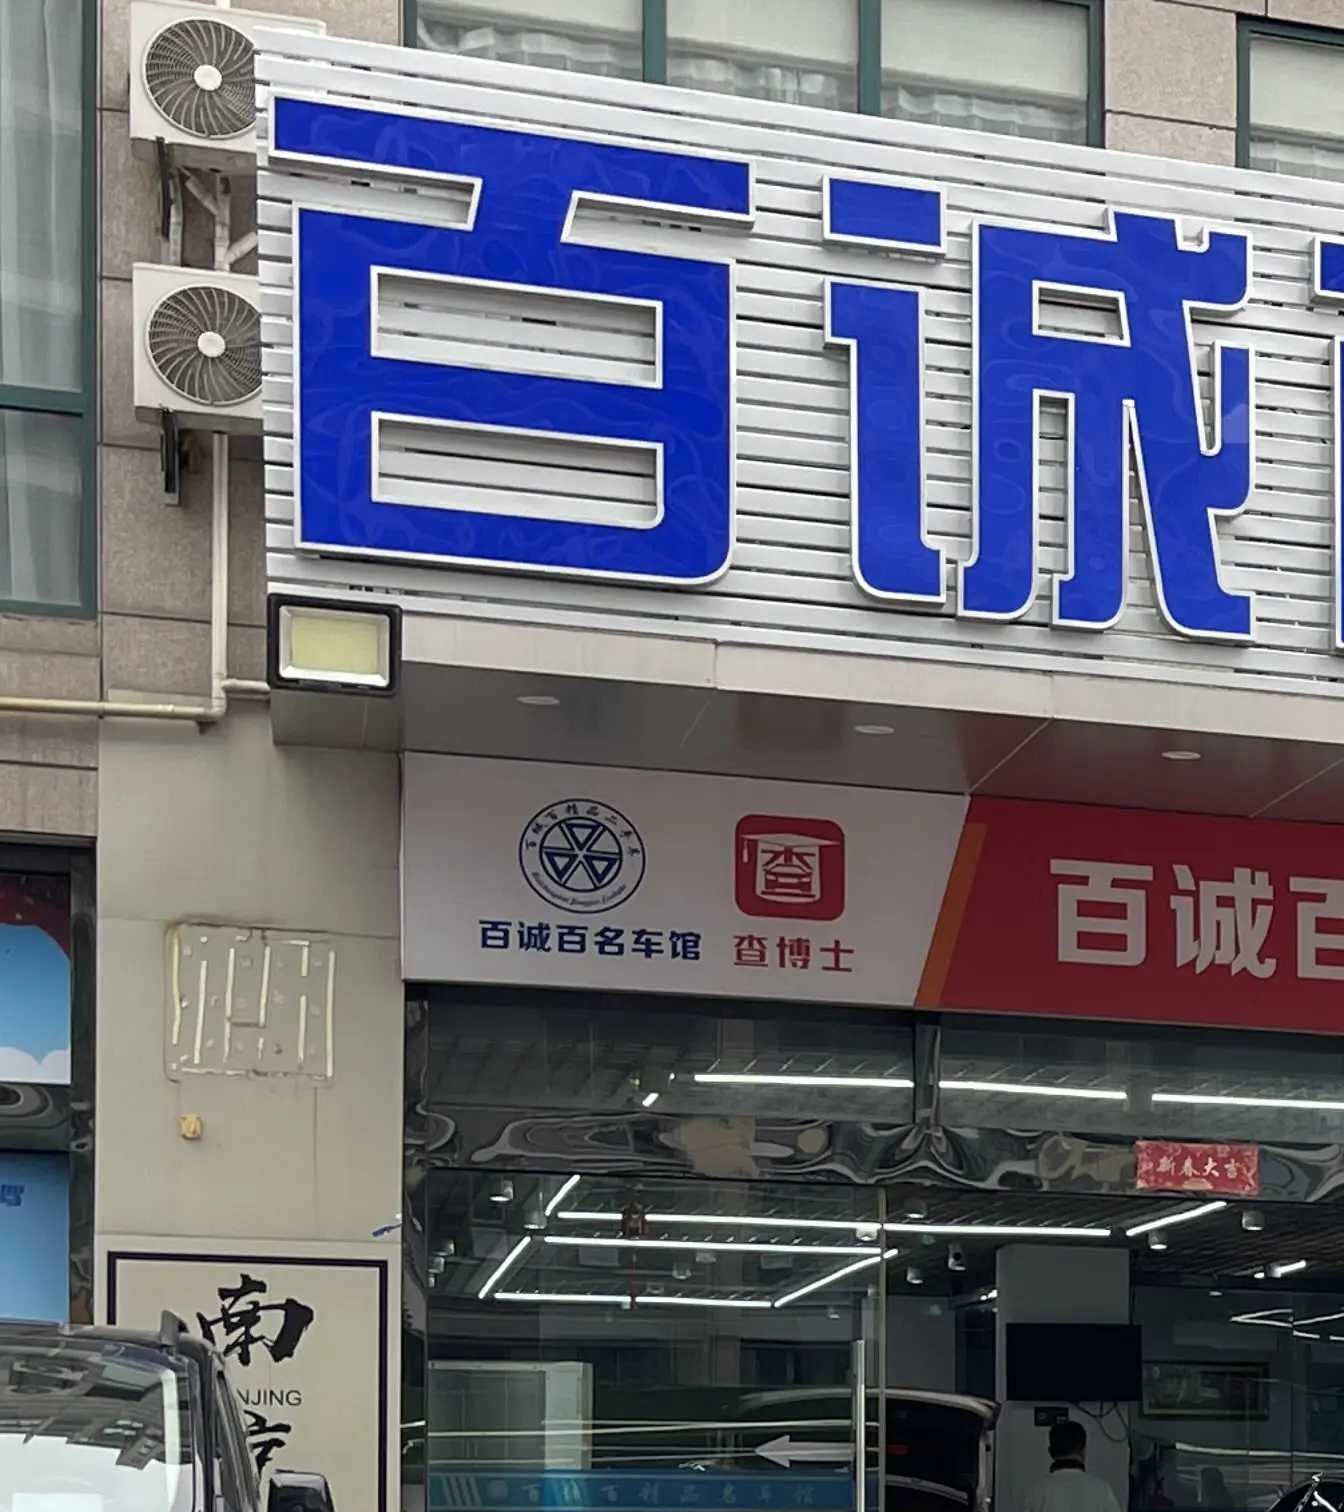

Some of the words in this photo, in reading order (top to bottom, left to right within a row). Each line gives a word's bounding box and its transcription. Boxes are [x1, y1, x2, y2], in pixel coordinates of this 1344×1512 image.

[479, 919, 702, 961] 百诚百名车馆
[733, 934, 854, 973] 查博士
[1155, 1155, 1241, 1180] 新春大吉
[196, 1273, 315, 1367] 南
[237, 1389, 303, 1407] NJING
